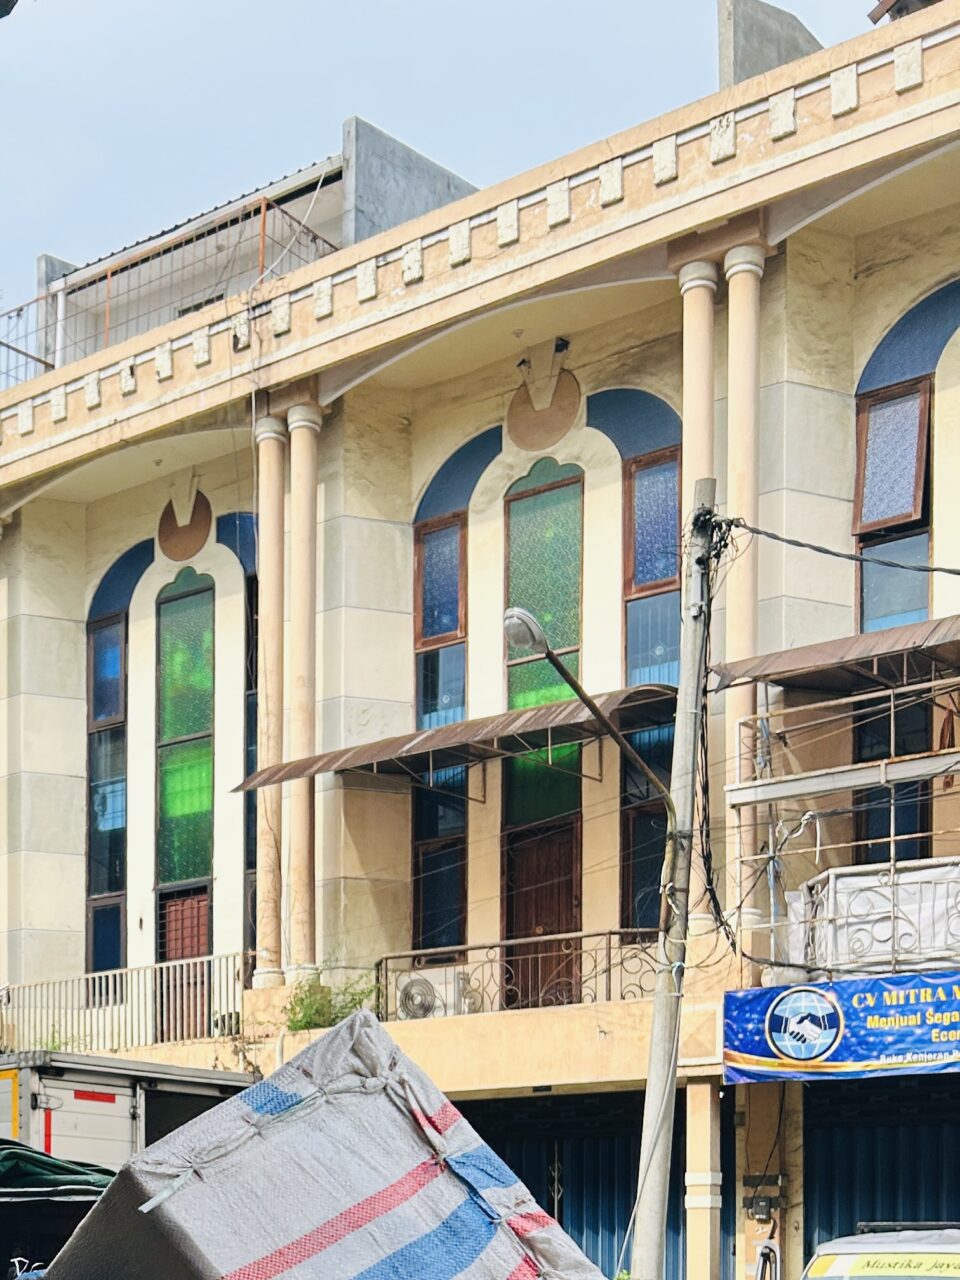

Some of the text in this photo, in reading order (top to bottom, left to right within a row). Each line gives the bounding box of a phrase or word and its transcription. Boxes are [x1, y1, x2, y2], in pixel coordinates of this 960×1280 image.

[852, 992, 878, 1008] CV
[883, 987, 946, 1006] MITRA
[867, 1014, 921, 1029] Menjual
[862, 1258, 924, 1270] Mustika
